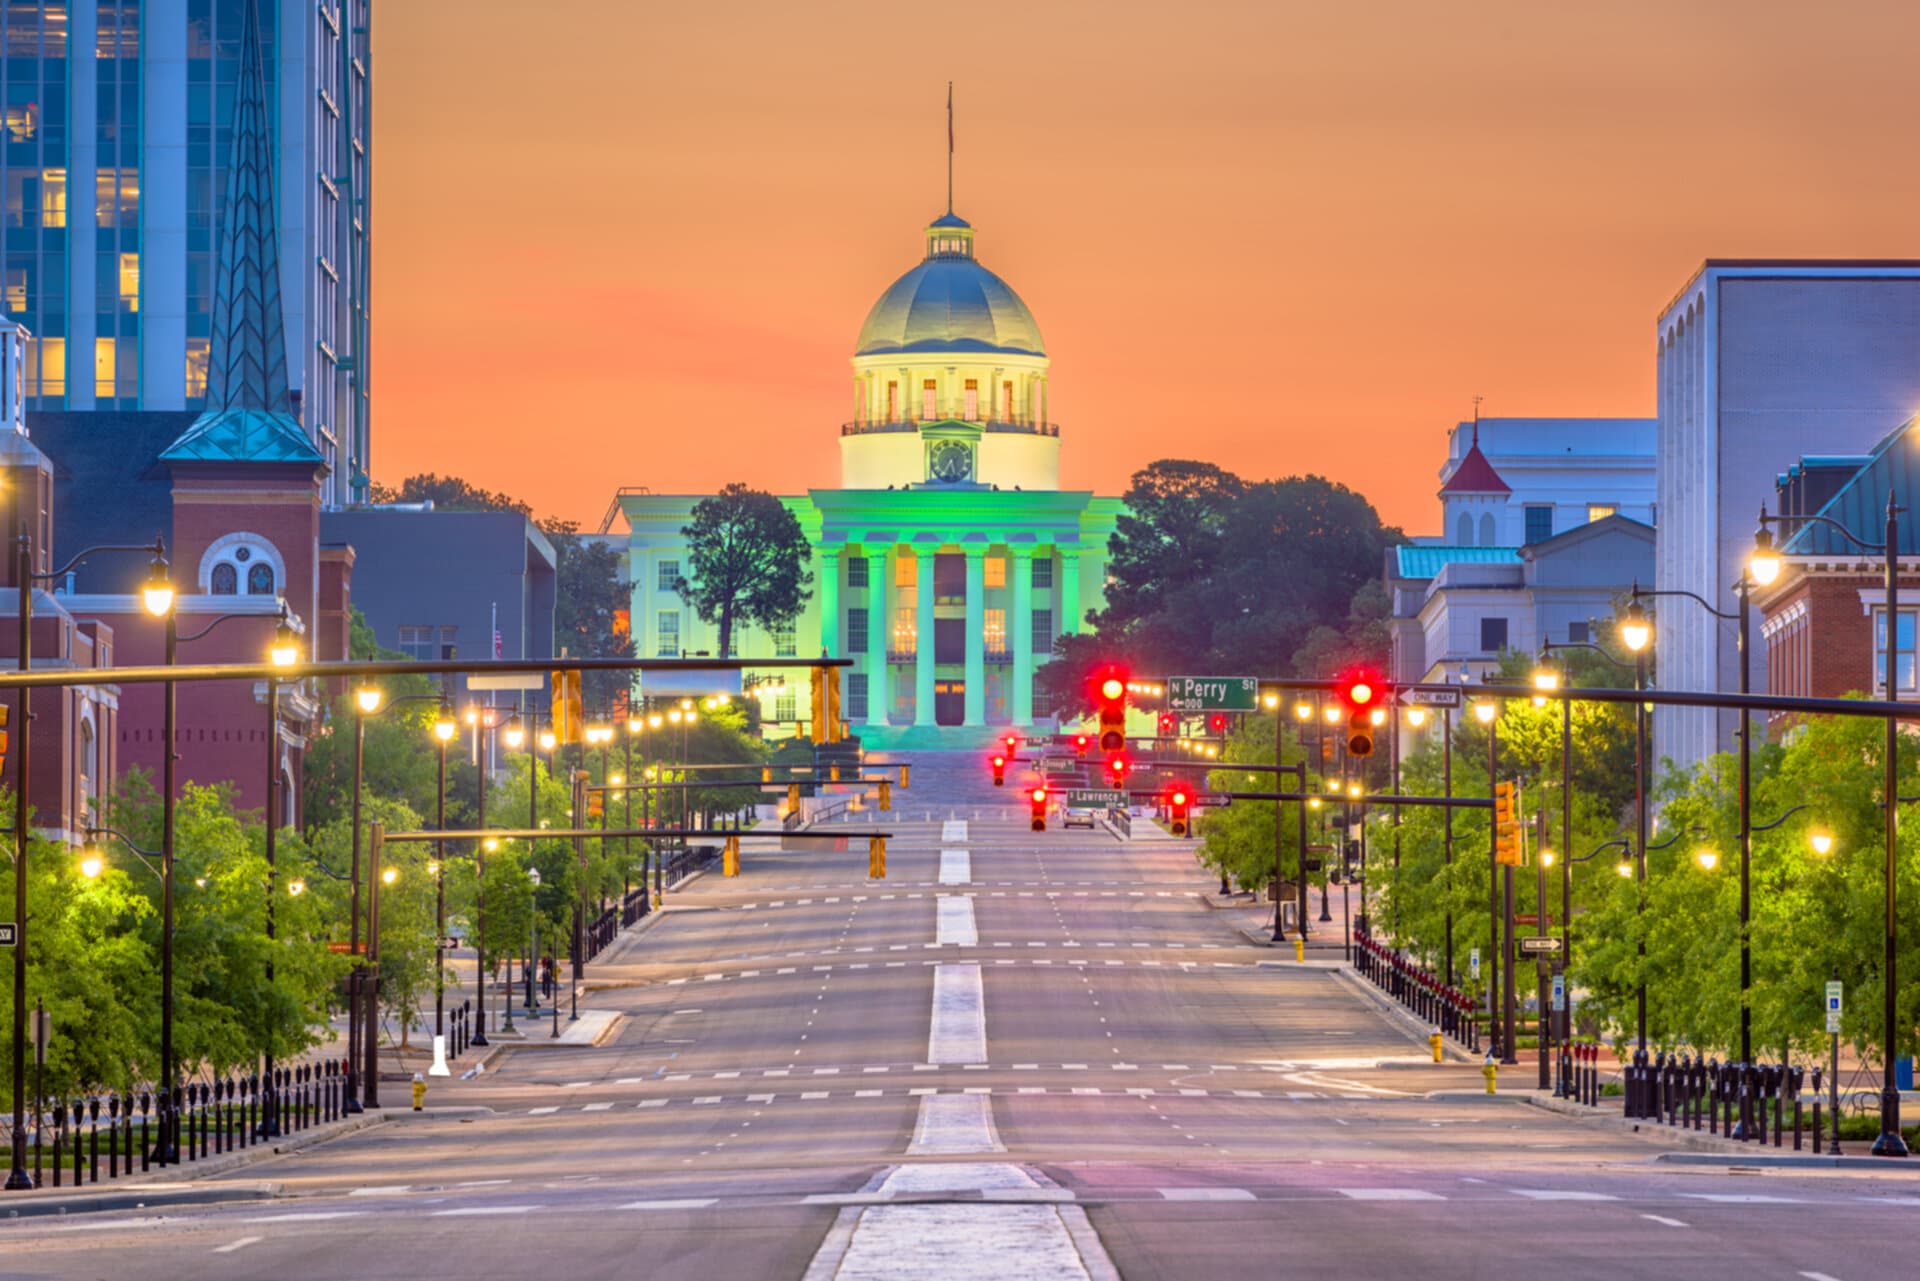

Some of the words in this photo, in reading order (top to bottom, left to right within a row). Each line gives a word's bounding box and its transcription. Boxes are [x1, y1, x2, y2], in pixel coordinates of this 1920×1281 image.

[1171, 682, 1180, 693] N
[1185, 679, 1227, 702] Perry
[1242, 679, 1254, 690] St
[1076, 790, 1118, 802] Lawrence
